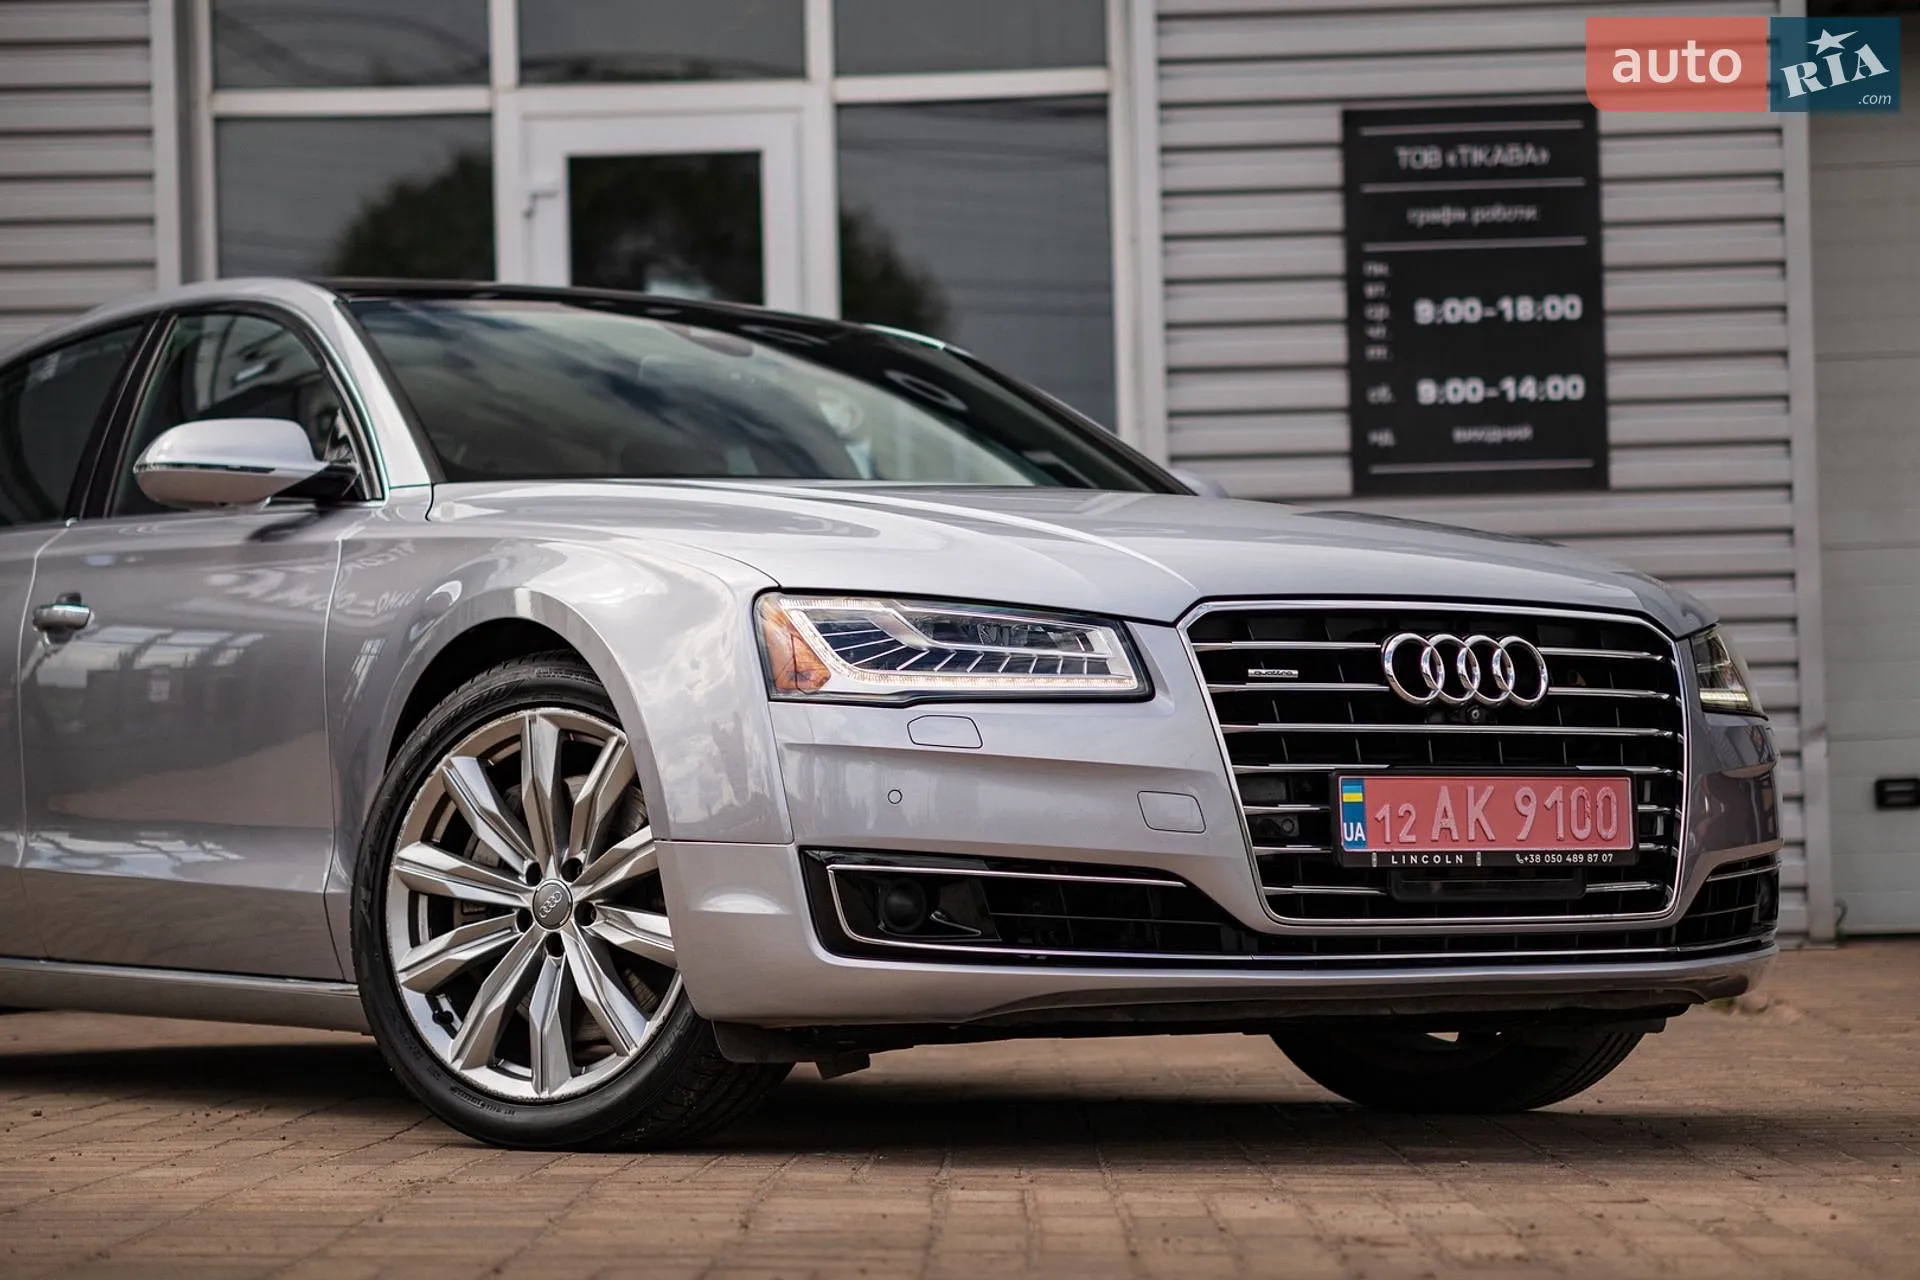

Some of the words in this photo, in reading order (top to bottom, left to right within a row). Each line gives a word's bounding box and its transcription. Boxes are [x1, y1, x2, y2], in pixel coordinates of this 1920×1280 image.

[1414, 294, 1583, 325] 9:00-18:00
[1416, 374, 1586, 405] 9:00-14:00
[1375, 803, 1417, 843] 12
[1430, 785, 1496, 842] AK
[1514, 786, 1617, 841] 9100
[1343, 822, 1366, 842] UA
[1391, 855, 1463, 864] LINCOLN
[1524, 854, 1541, 863] +38
[1544, 854, 1562, 863] 050
[1565, 854, 1585, 863] 489
[1586, 853, 1599, 863] 87
[1601, 853, 1614, 863] 07
